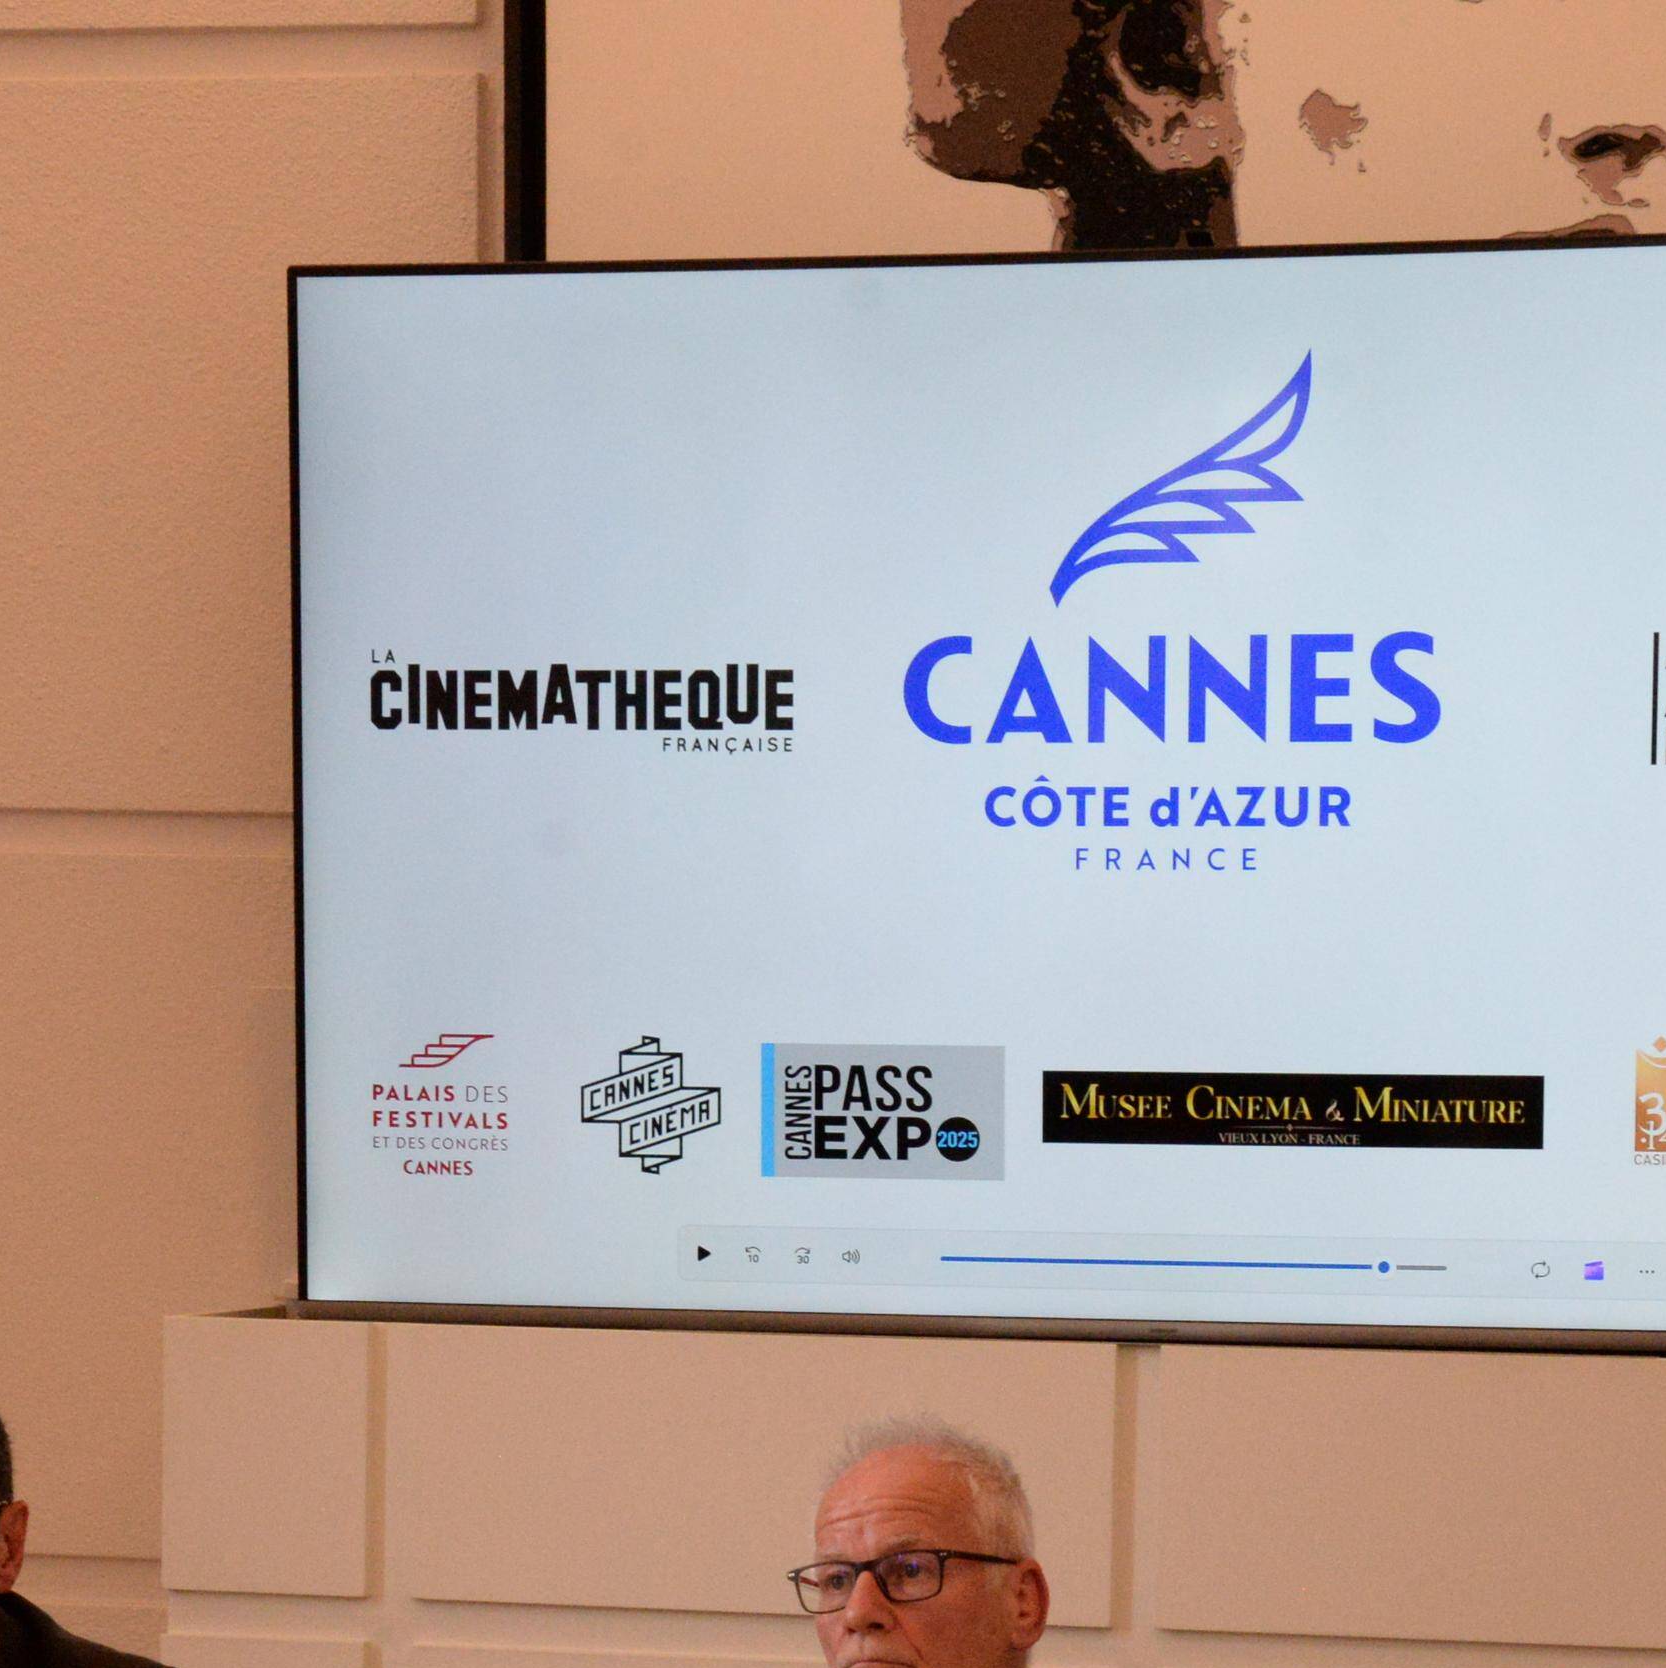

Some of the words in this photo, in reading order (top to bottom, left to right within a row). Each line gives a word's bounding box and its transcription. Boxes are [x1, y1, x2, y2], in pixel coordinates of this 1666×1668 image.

[371, 648, 395, 664] LA
[370, 663, 794, 731] CINEMATHEQUE
[903, 630, 1441, 744] CANNES
[662, 735, 794, 755] FRANÇAISE
[984, 774, 1130, 828] CÔTE
[1150, 784, 1351, 828] d'AZUR
[1075, 847, 1258, 871] FRANCE
[372, 1084, 455, 1101] PALAIS
[466, 1085, 509, 1103] DES
[590, 1064, 674, 1111] CANNES
[814, 1064, 933, 1112] PASS
[372, 1110, 508, 1130] FESTIVALS
[629, 1099, 710, 1145] CINÉMA
[785, 1064, 812, 1160] CANNES
[1325, 1101, 1345, 1123] &
[372, 1136, 389, 1149] ET
[396, 1137, 426, 1149] DES
[431, 1135, 508, 1151] CONGRÈS
[937, 1131, 978, 1149] 2025
[1218, 1132, 1259, 1144] VIEUX
[1262, 1133, 1298, 1145] LYON
[1309, 1133, 1361, 1145] FRANCE
[403, 1159, 473, 1176] CANNES
[748, 1254, 760, 1263] 10
[797, 1255, 810, 1264] 30
